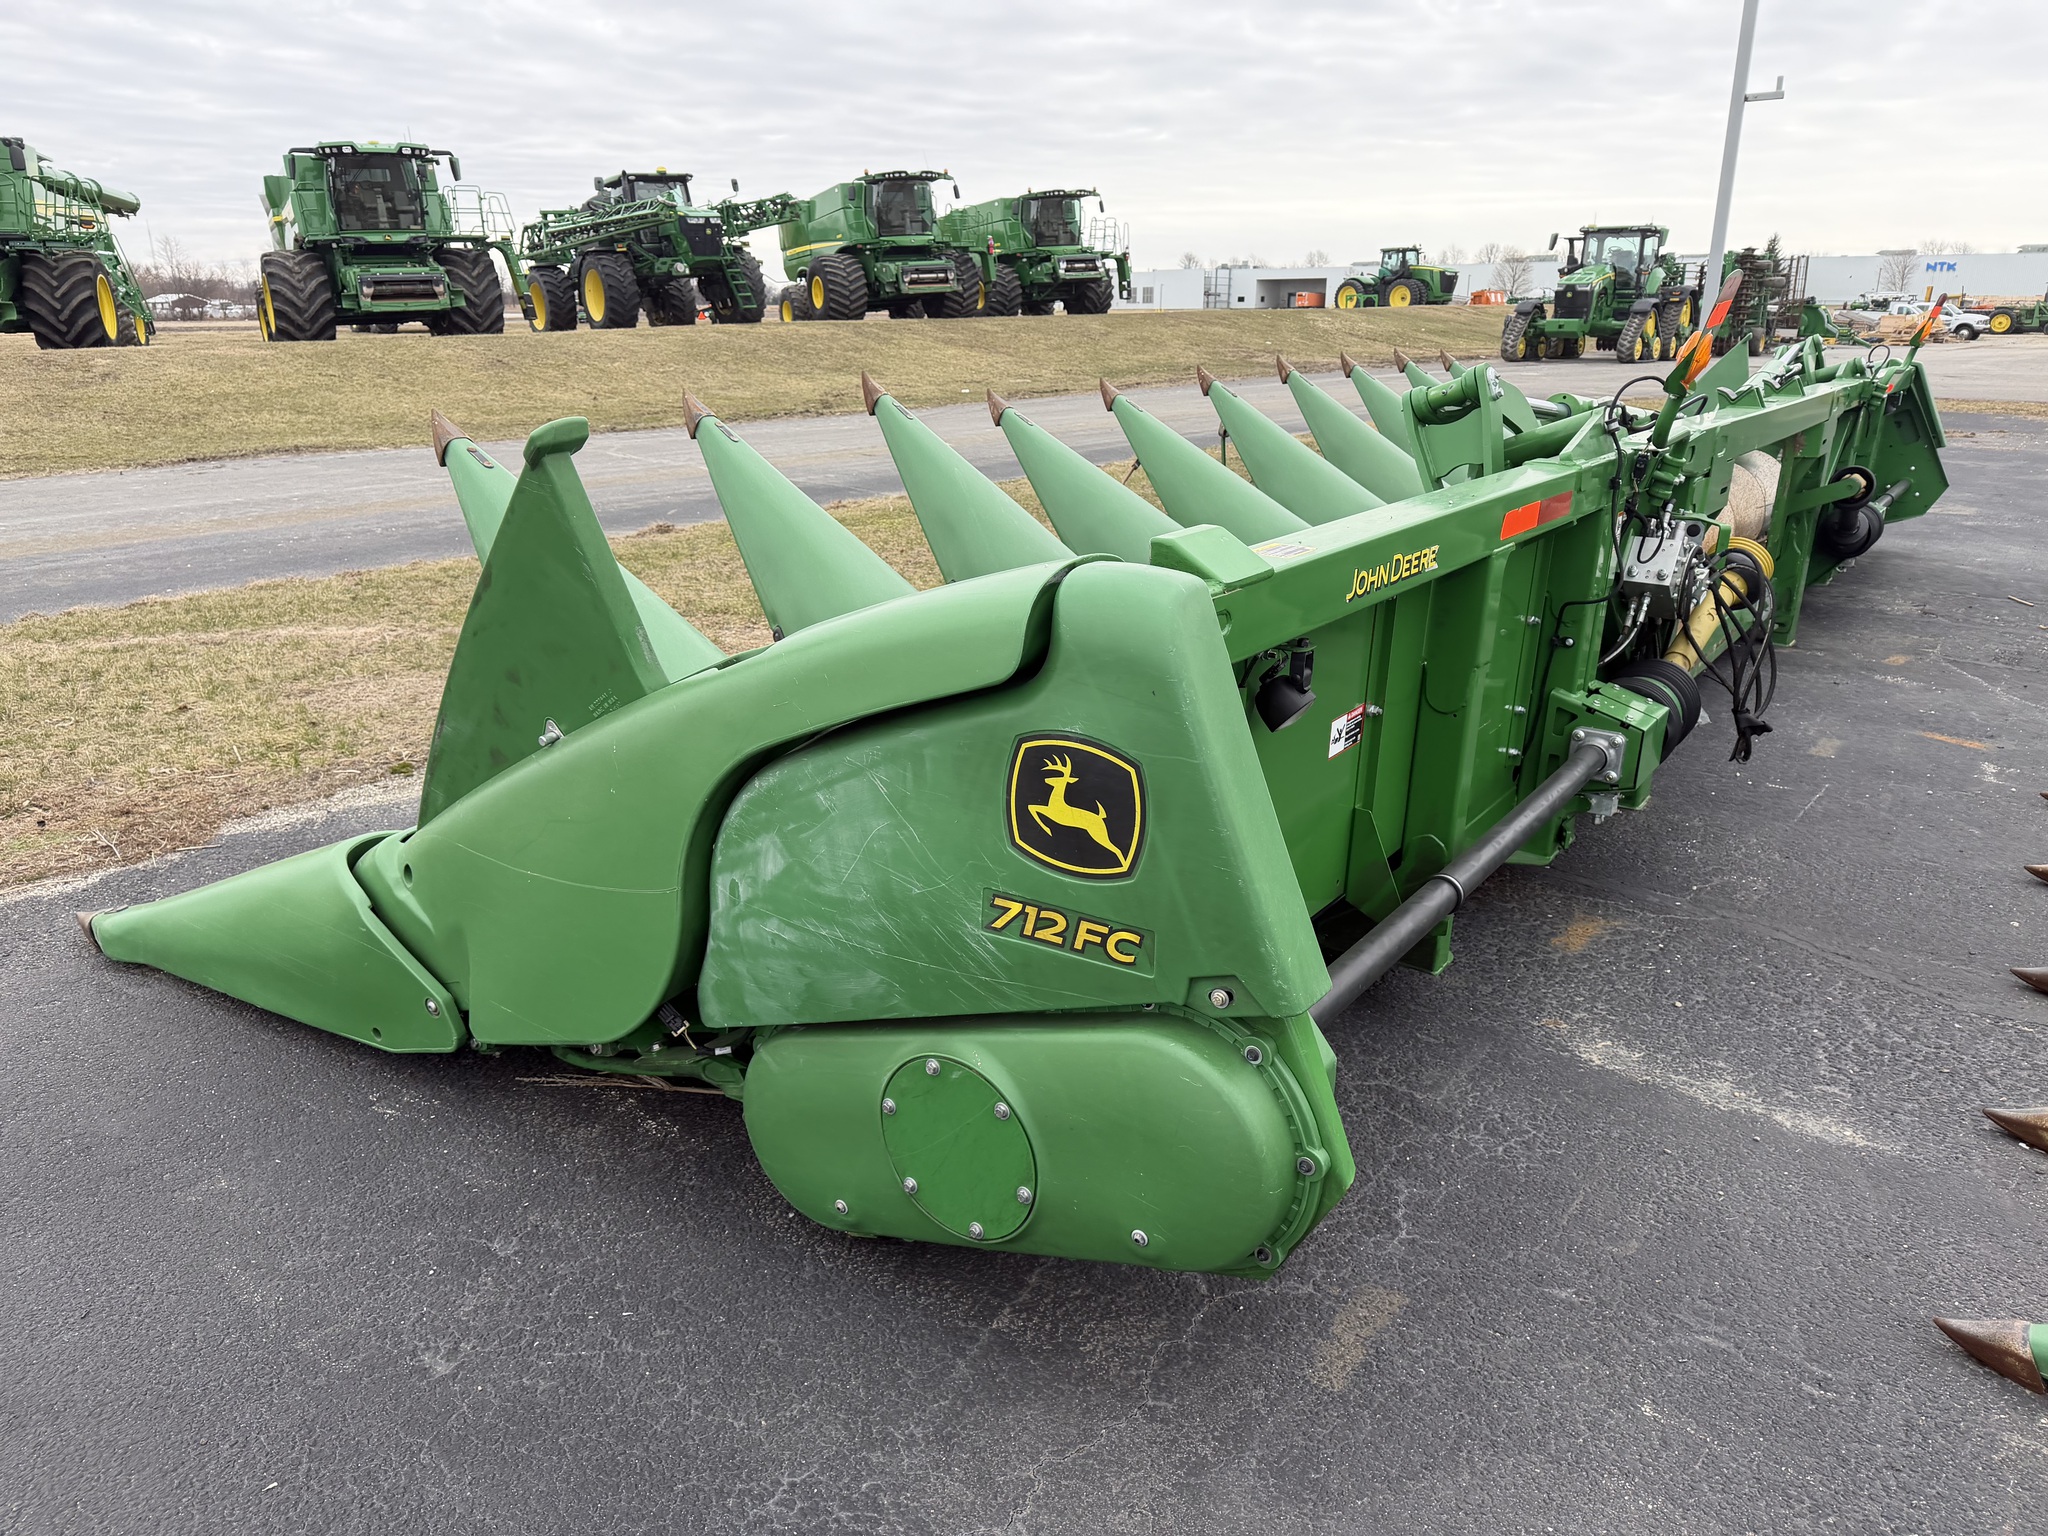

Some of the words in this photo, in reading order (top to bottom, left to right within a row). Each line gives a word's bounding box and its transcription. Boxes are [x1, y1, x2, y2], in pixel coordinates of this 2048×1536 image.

[1926, 261, 1957, 272] NTK
[1345, 562, 1390, 603] JOHN
[1390, 545, 1440, 584] DEERE
[988, 895, 1067, 946] 712
[1072, 918, 1143, 964] FC
